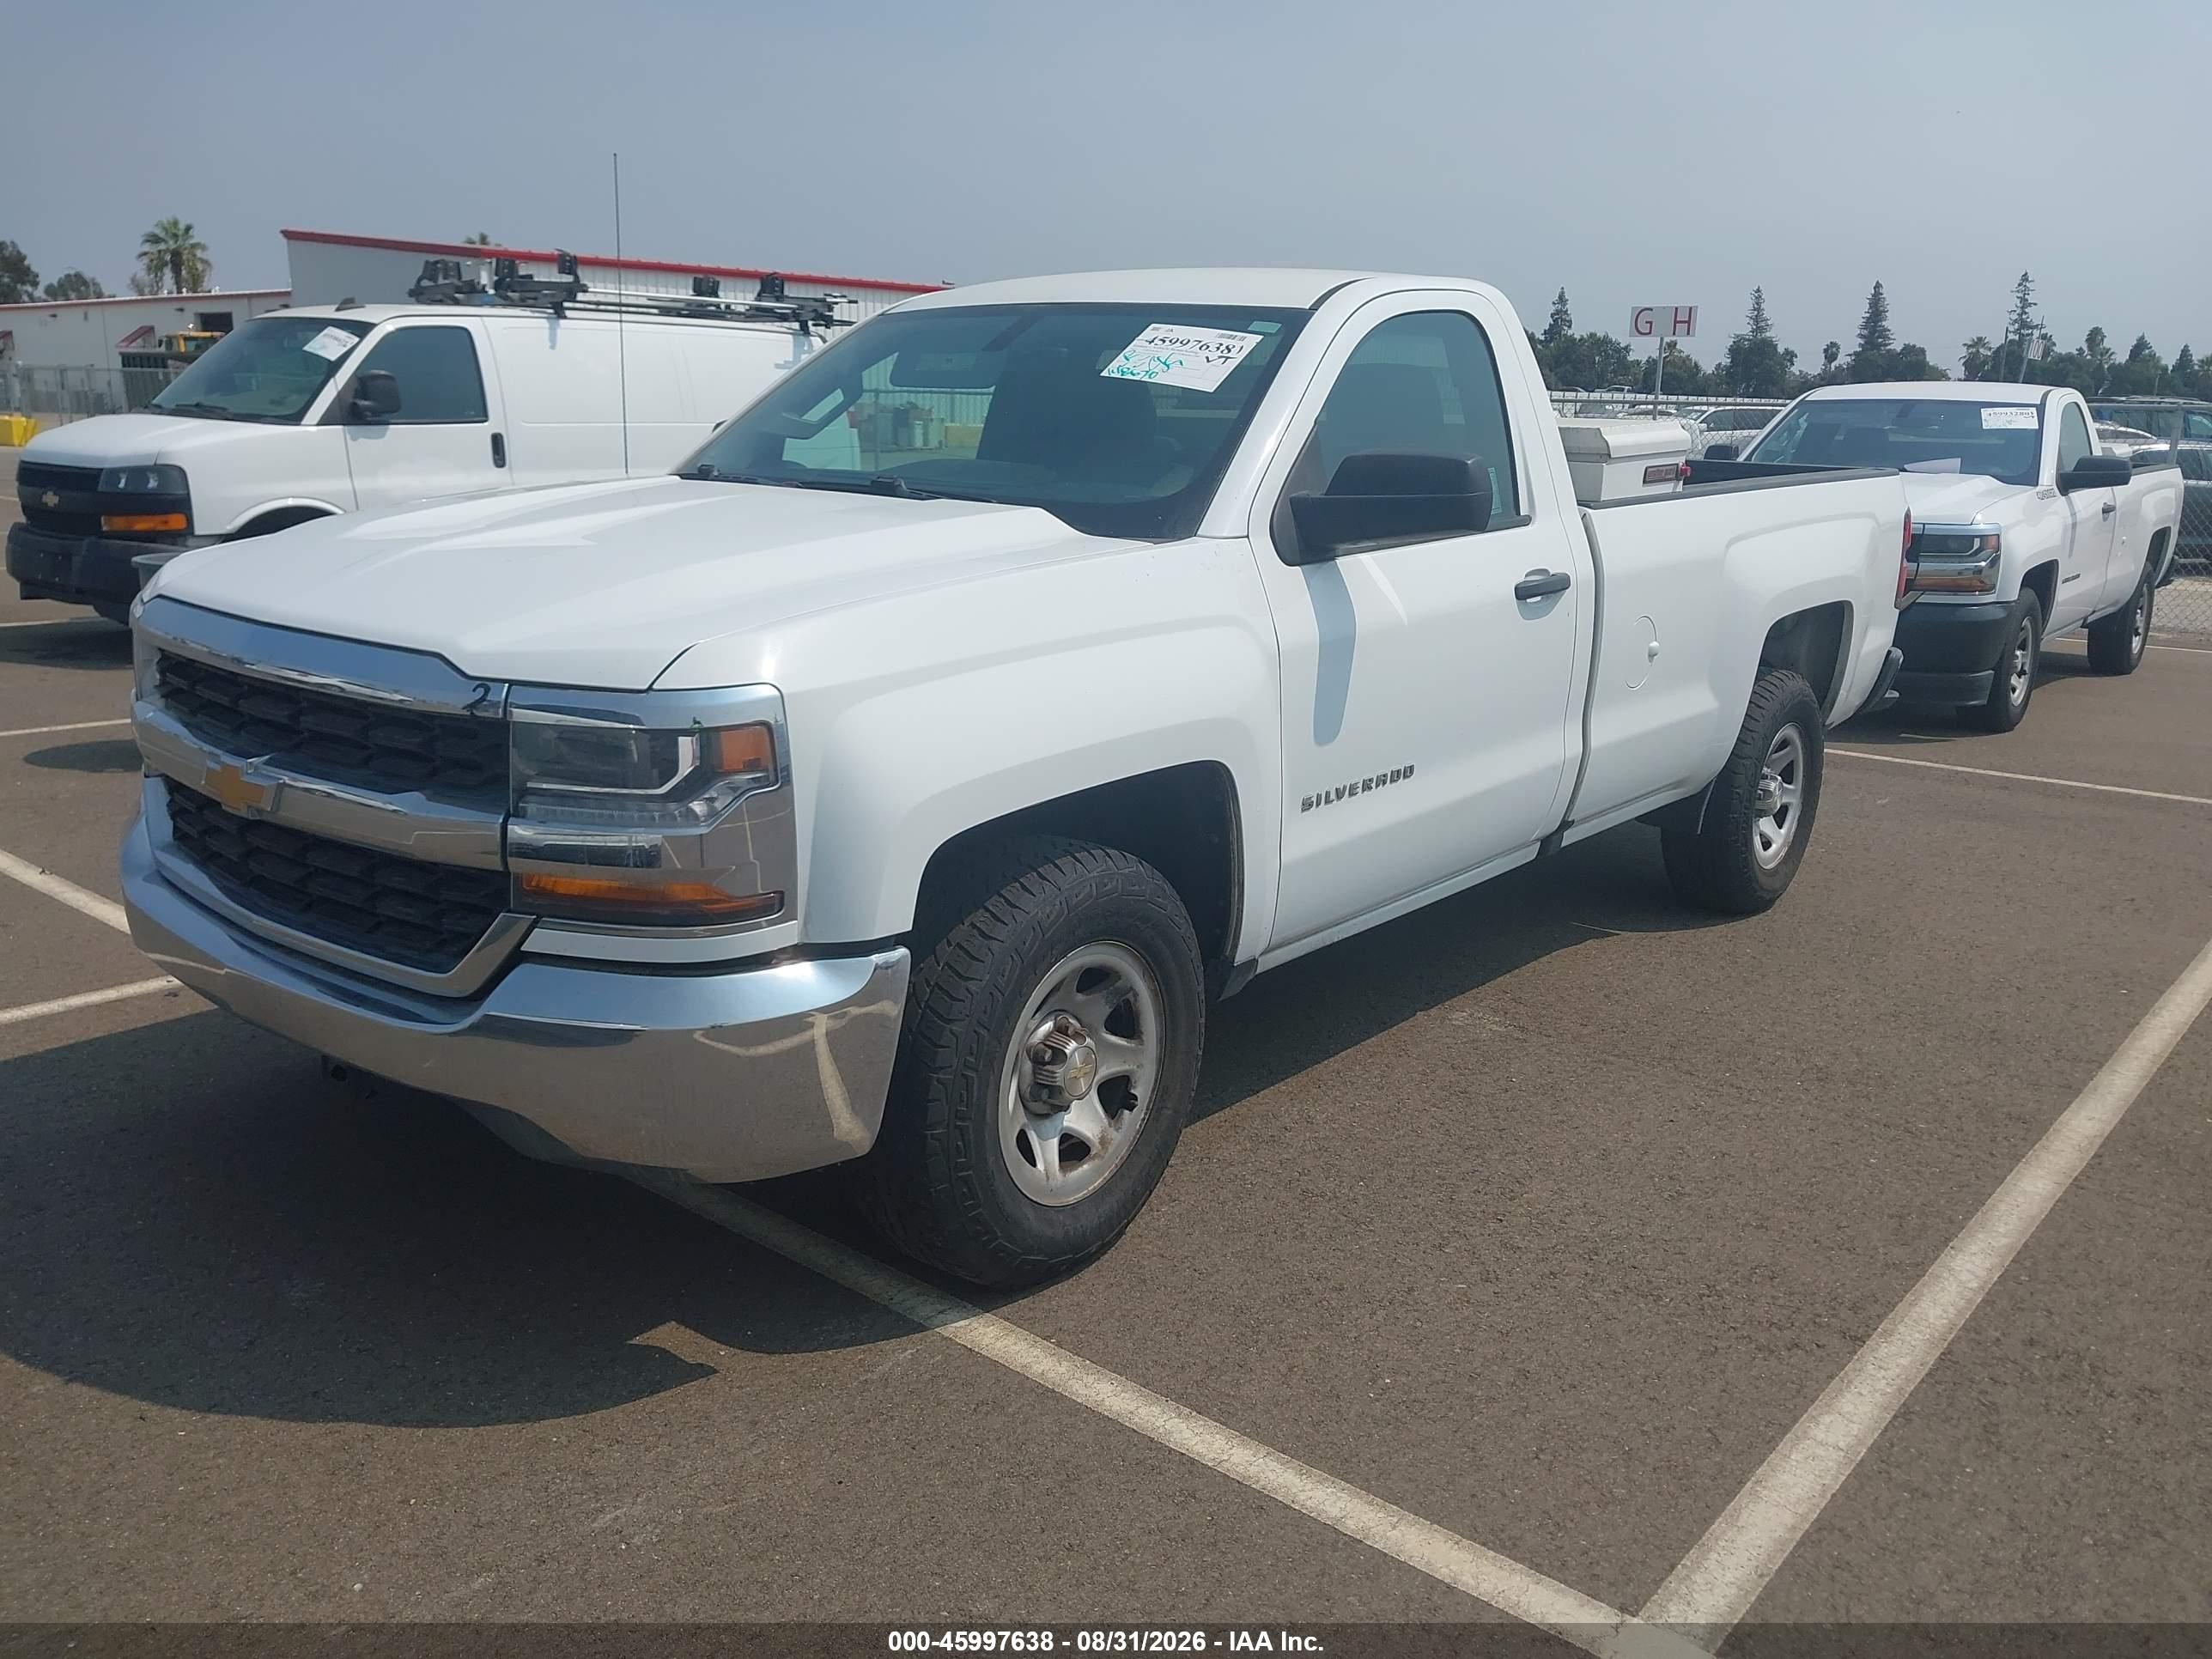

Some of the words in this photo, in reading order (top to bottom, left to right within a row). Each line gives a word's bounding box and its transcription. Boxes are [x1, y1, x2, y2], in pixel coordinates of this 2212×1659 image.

[1634, 307, 1653, 336] G
[1672, 307, 1692, 336] H
[1300, 763, 1415, 813] SILVERADO
